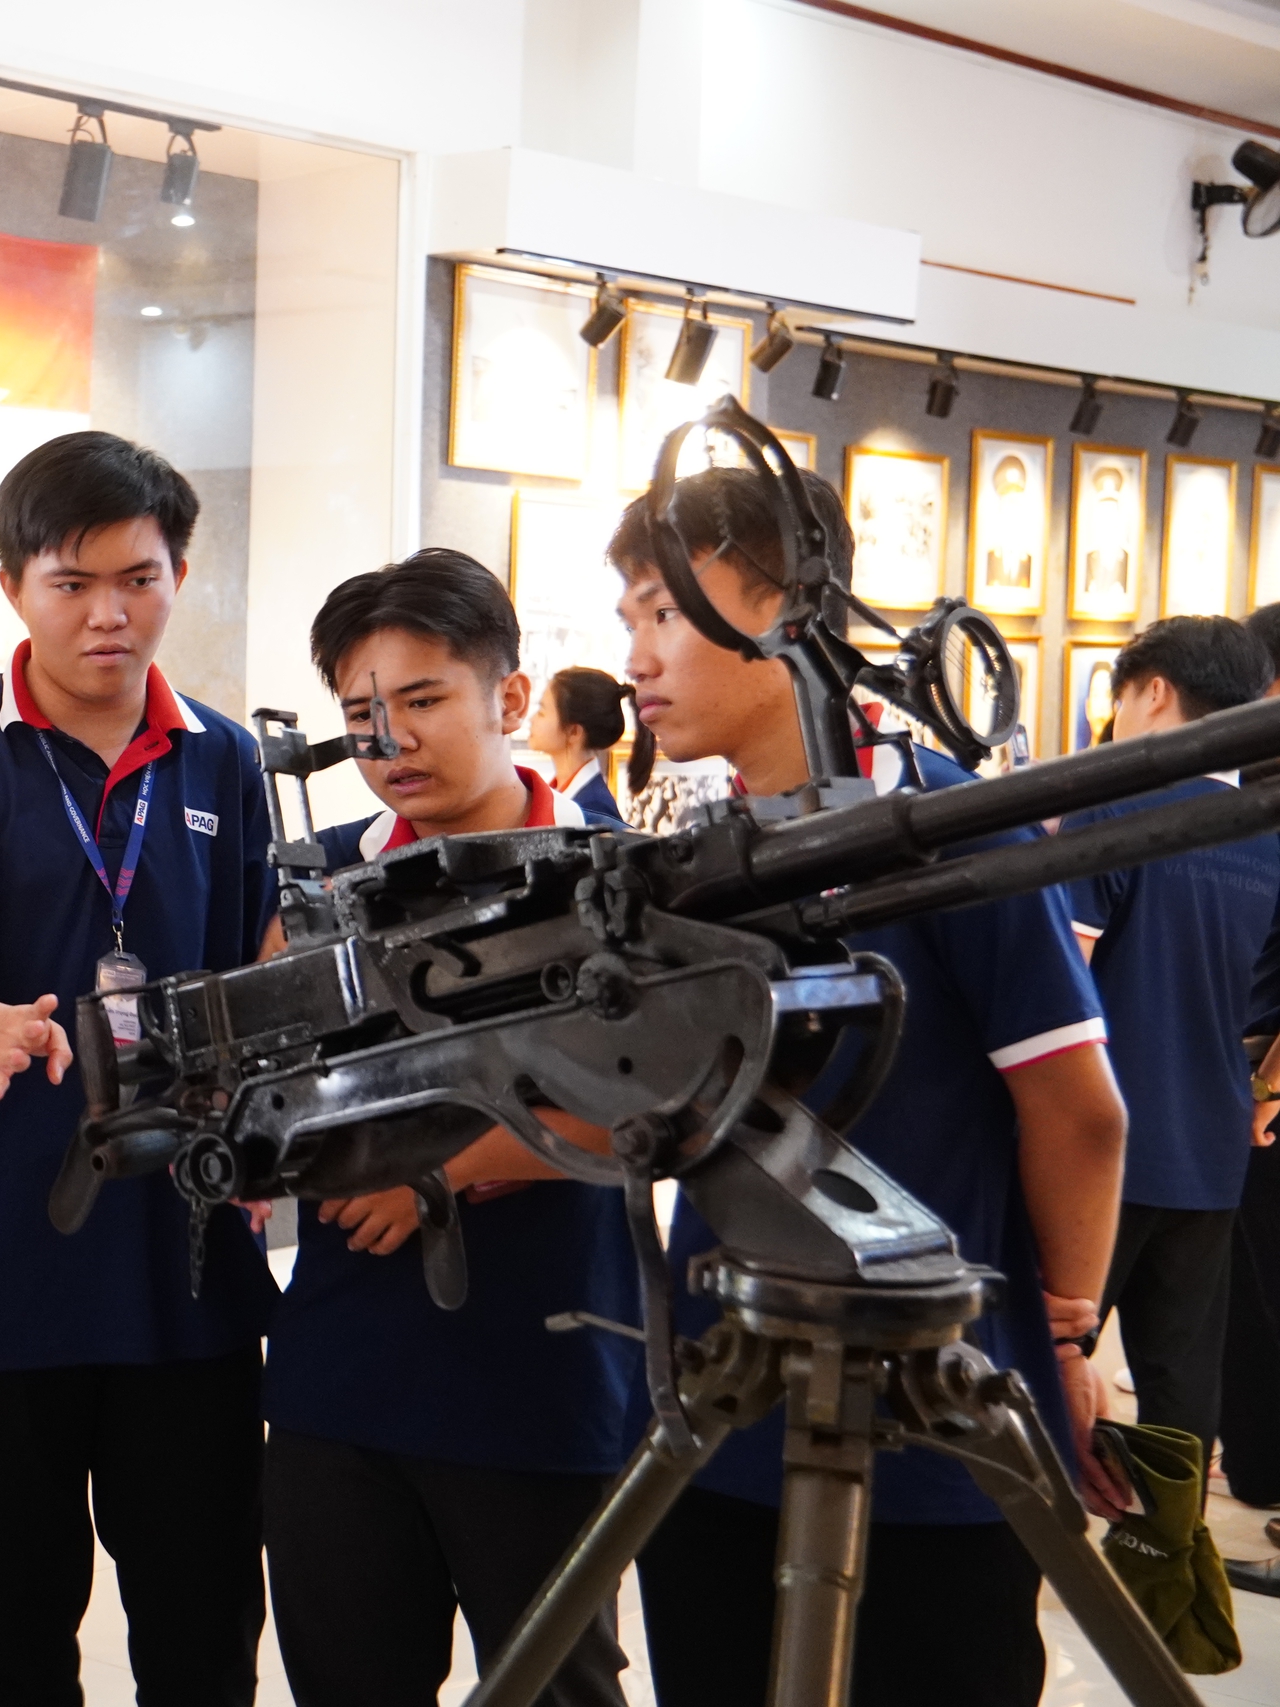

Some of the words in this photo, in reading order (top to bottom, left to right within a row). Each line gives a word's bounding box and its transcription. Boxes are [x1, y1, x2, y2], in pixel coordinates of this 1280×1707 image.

[136, 802, 146, 824] APAG
[185, 811, 215, 832] APAG
[68, 806, 91, 844] GOVERNANCE
